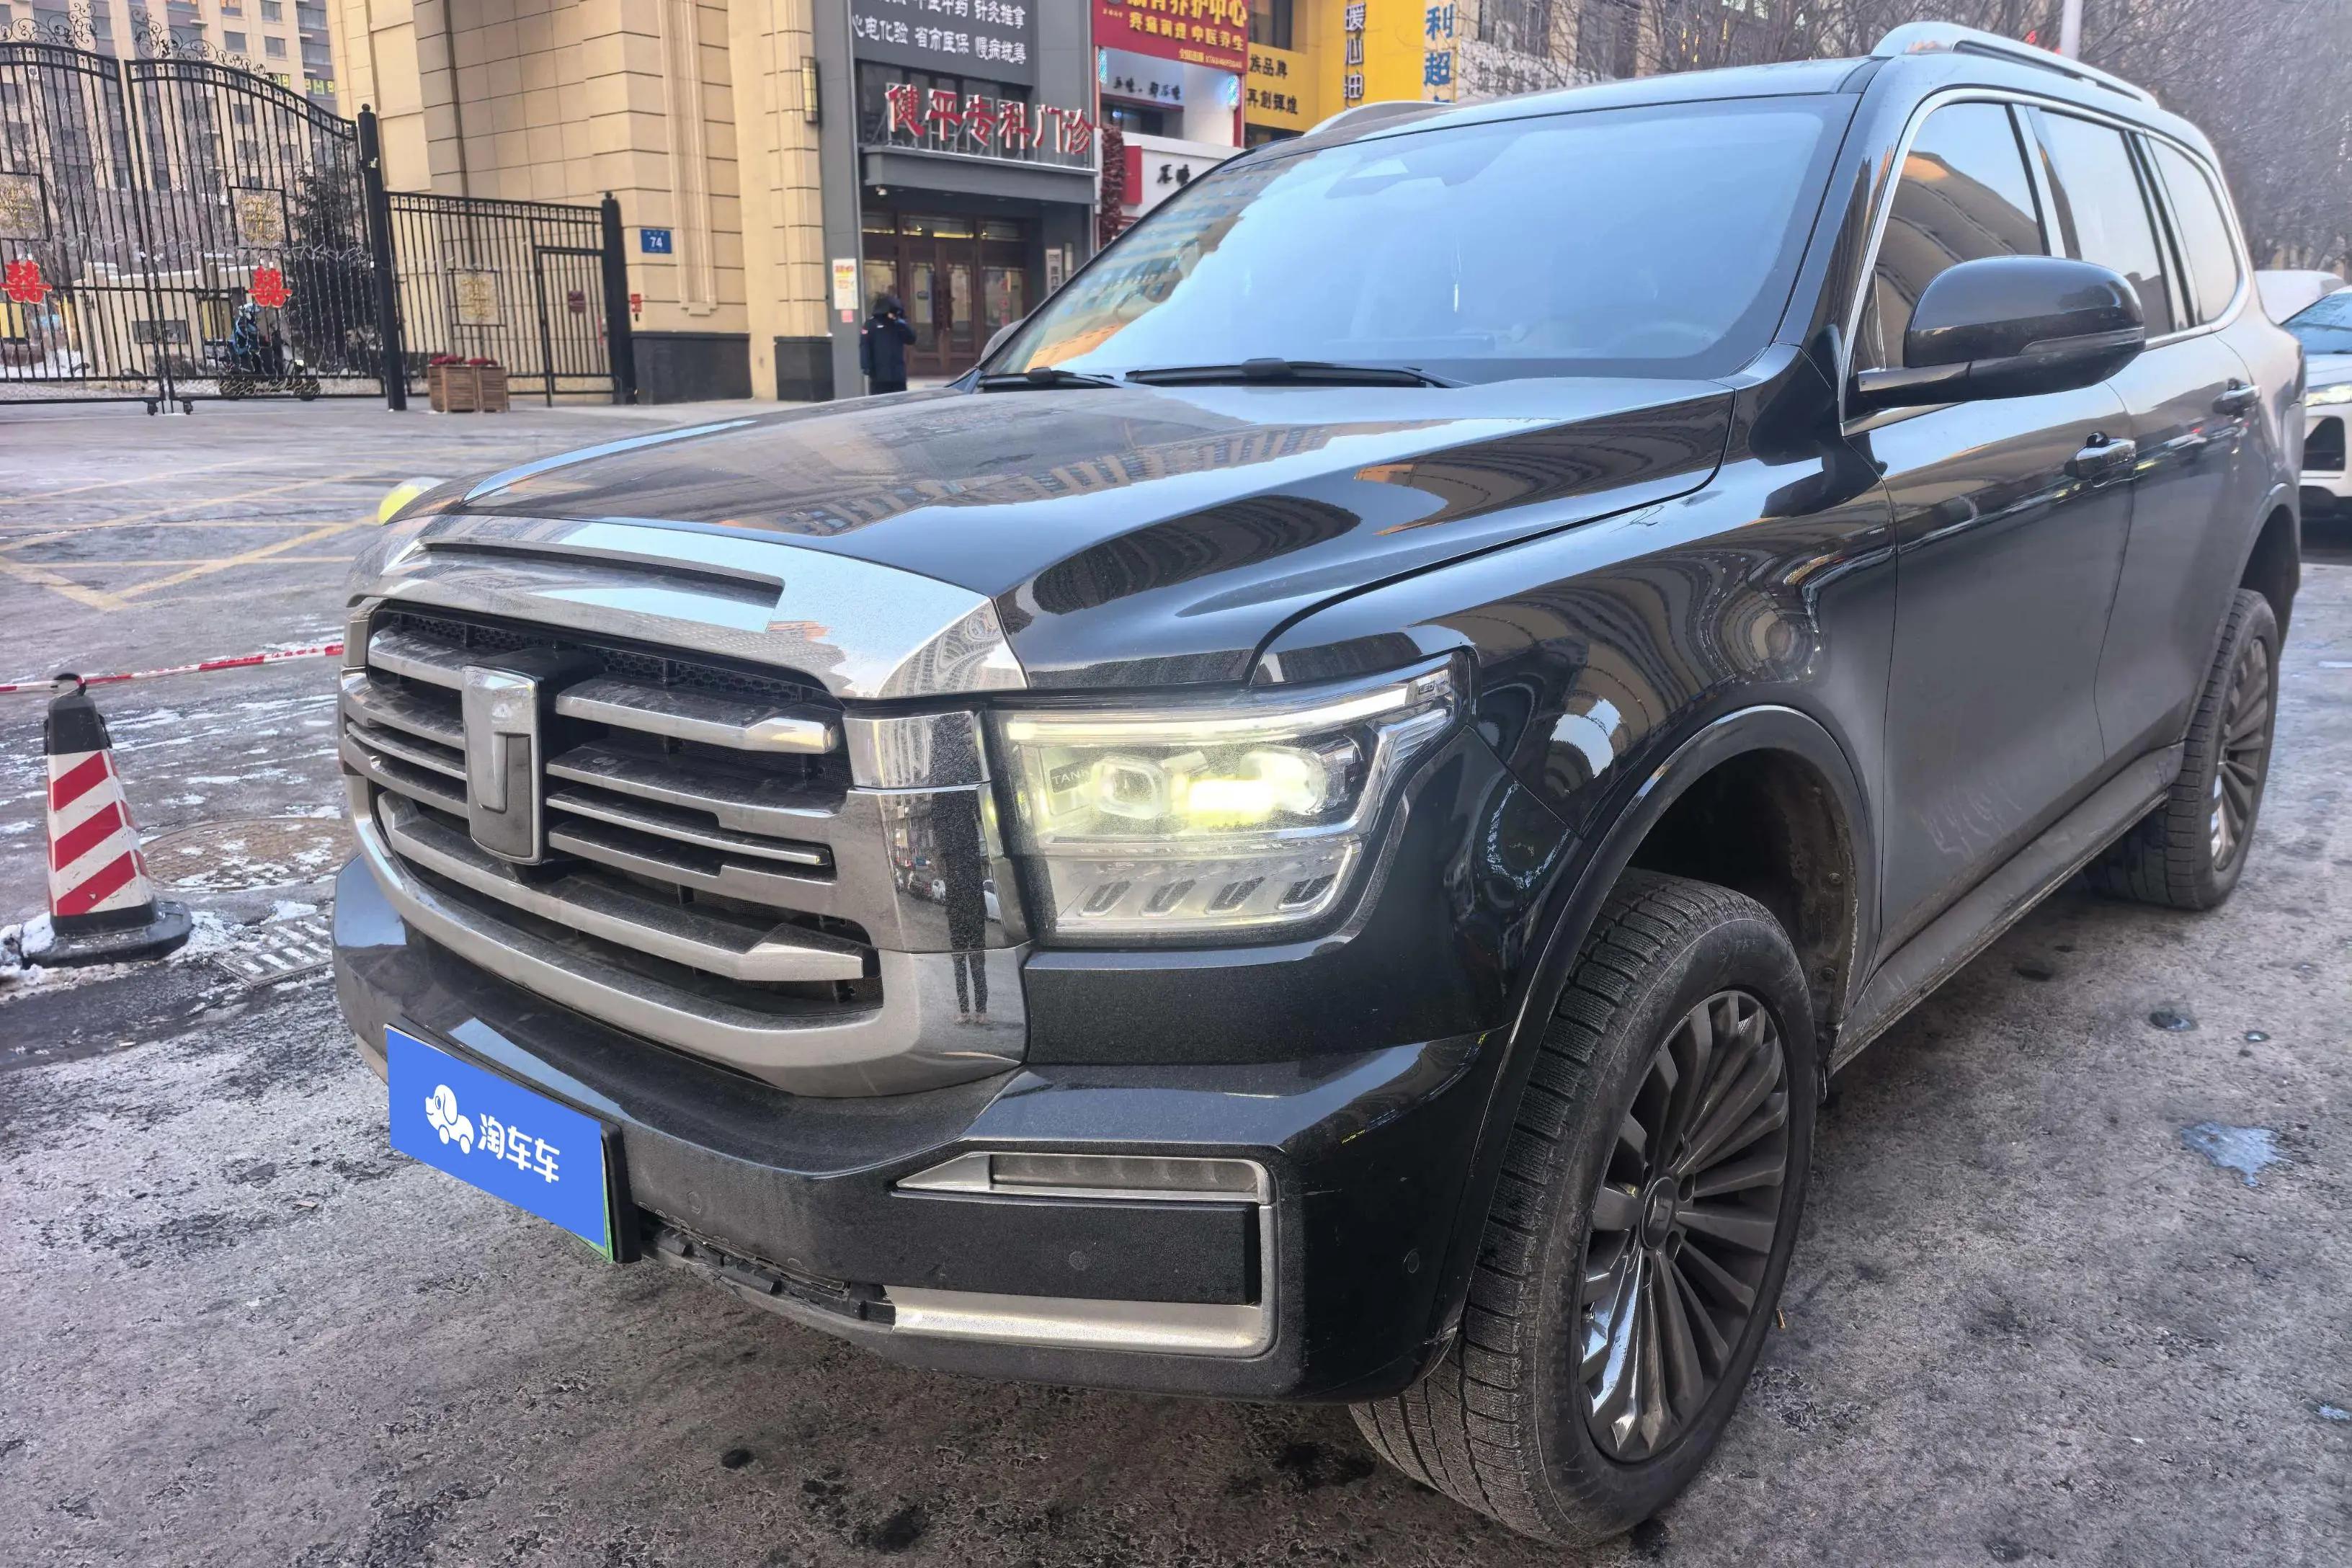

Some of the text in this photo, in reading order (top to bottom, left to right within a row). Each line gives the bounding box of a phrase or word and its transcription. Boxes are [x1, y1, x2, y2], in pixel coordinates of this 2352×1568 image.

[974, 0, 1026, 30] 针灸推拿
[852, 14, 909, 45] 心电化验
[914, 27, 970, 54] 省市医保
[1190, 25, 1244, 52] 中医养生
[1423, 4, 1456, 103] 利超
[649, 236, 663, 248] 74
